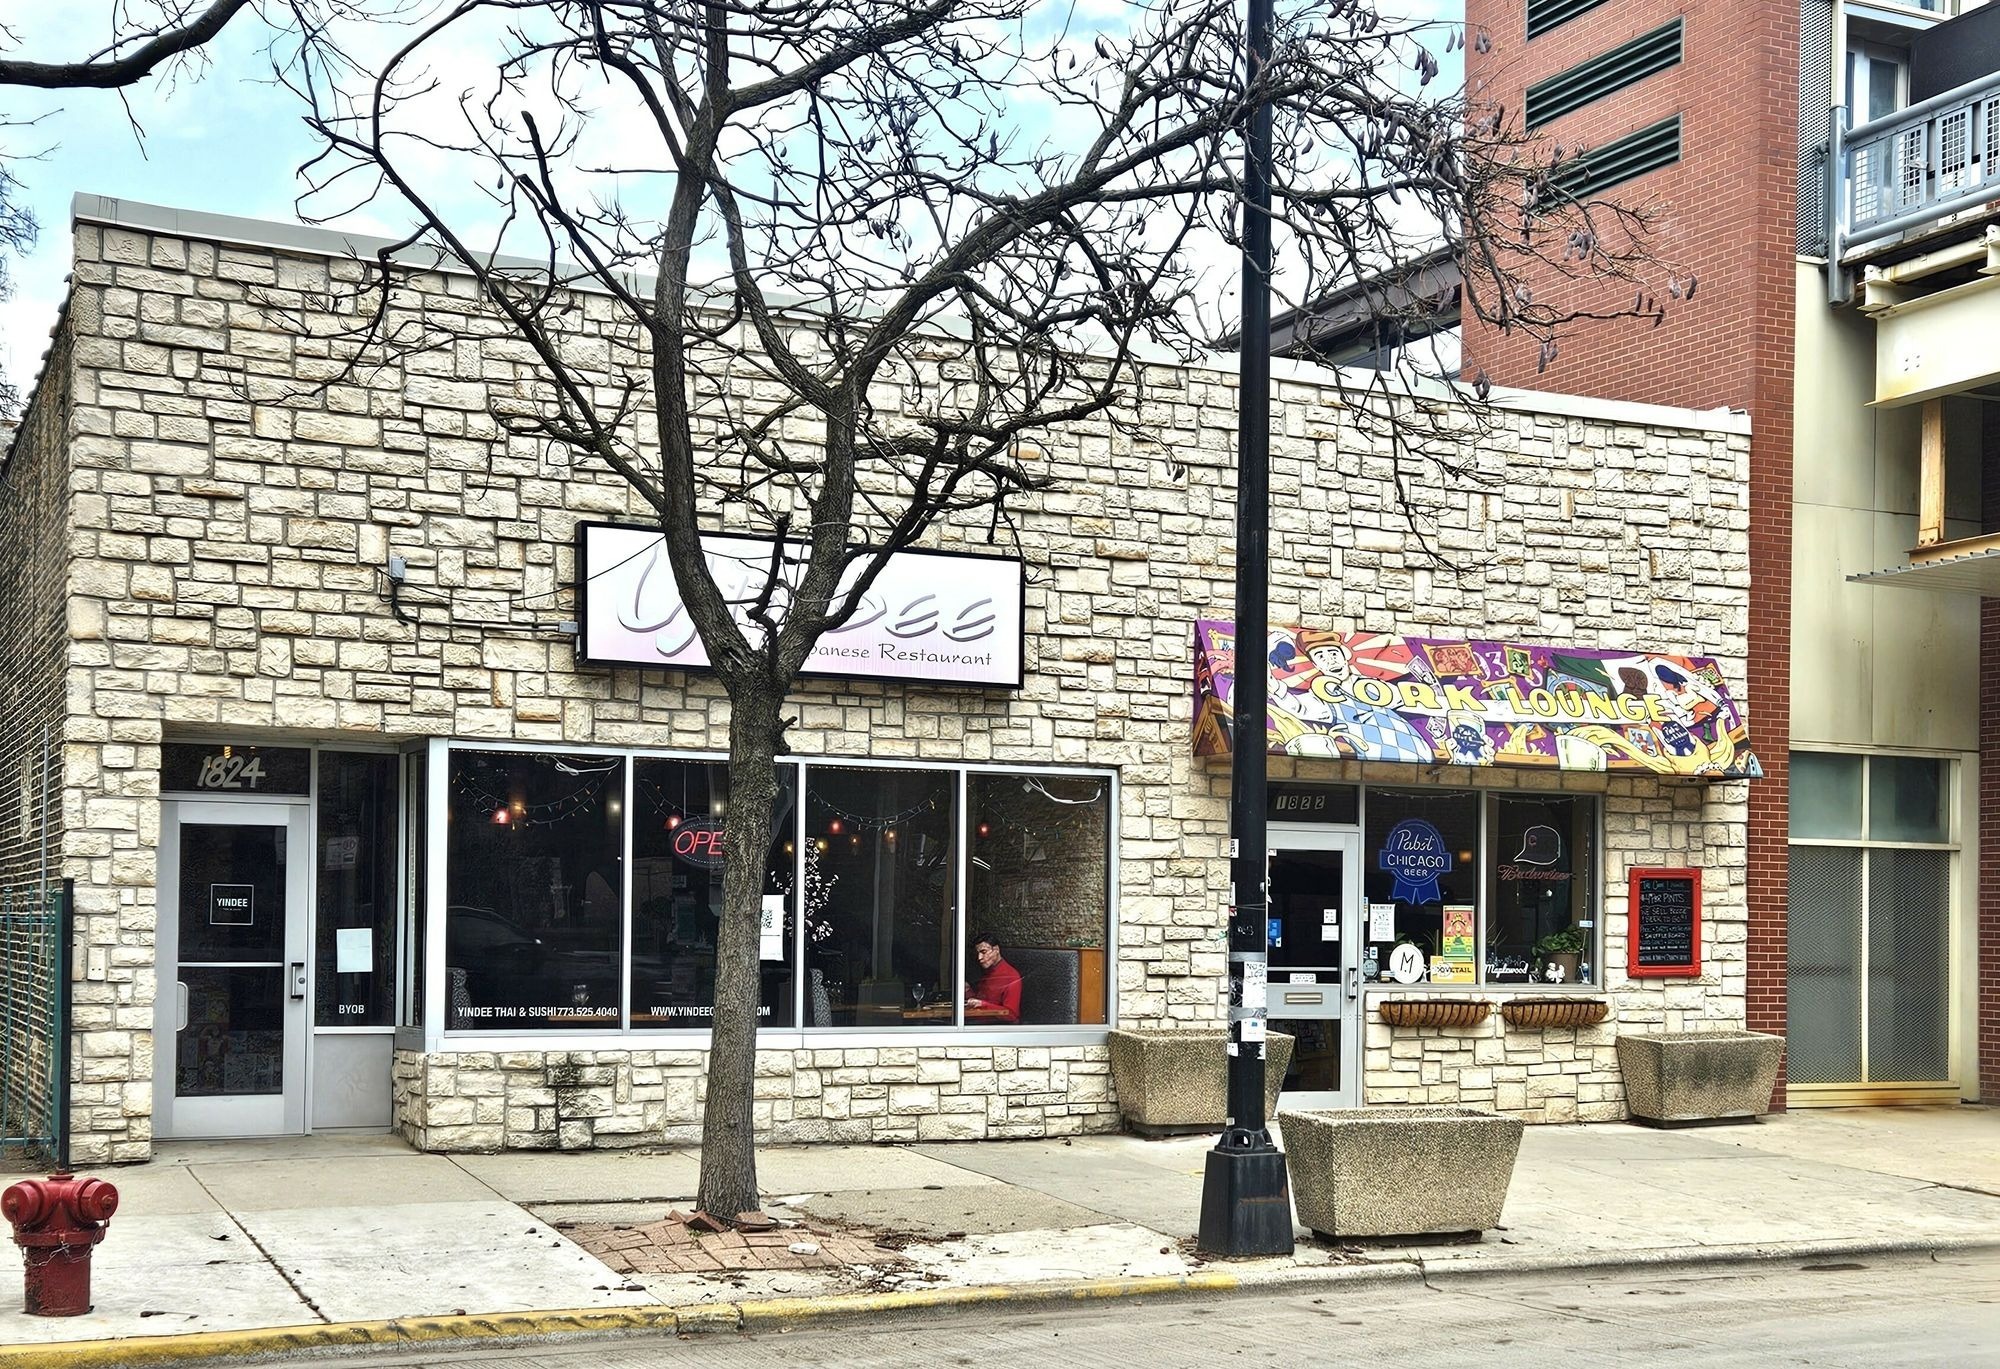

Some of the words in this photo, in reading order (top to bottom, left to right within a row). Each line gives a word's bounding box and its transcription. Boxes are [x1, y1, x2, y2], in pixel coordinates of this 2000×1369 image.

[878, 642, 992, 666] Restaurant
[1310, 674, 1488, 712] CORK
[1504, 686, 1673, 722] LOUNGE
[196, 755, 266, 789] 1824
[1276, 795, 1326, 811] 1822
[674, 830, 725, 856] OPE
[1396, 829, 1436, 852] Pabst
[1386, 853, 1445, 869] CHICAGO
[1403, 868, 1428, 878] BEER
[216, 897, 249, 908] YINDEE
[1484, 961, 1529, 979] Maplewood
[338, 1004, 366, 1016] BYOB
[457, 1006, 493, 1017] YINDEE
[494, 1006, 517, 1017] THAI
[518, 1006, 527, 1017] &
[528, 1006, 556, 1017] SUSHI
[557, 1007, 618, 1017] 773.525.4040
